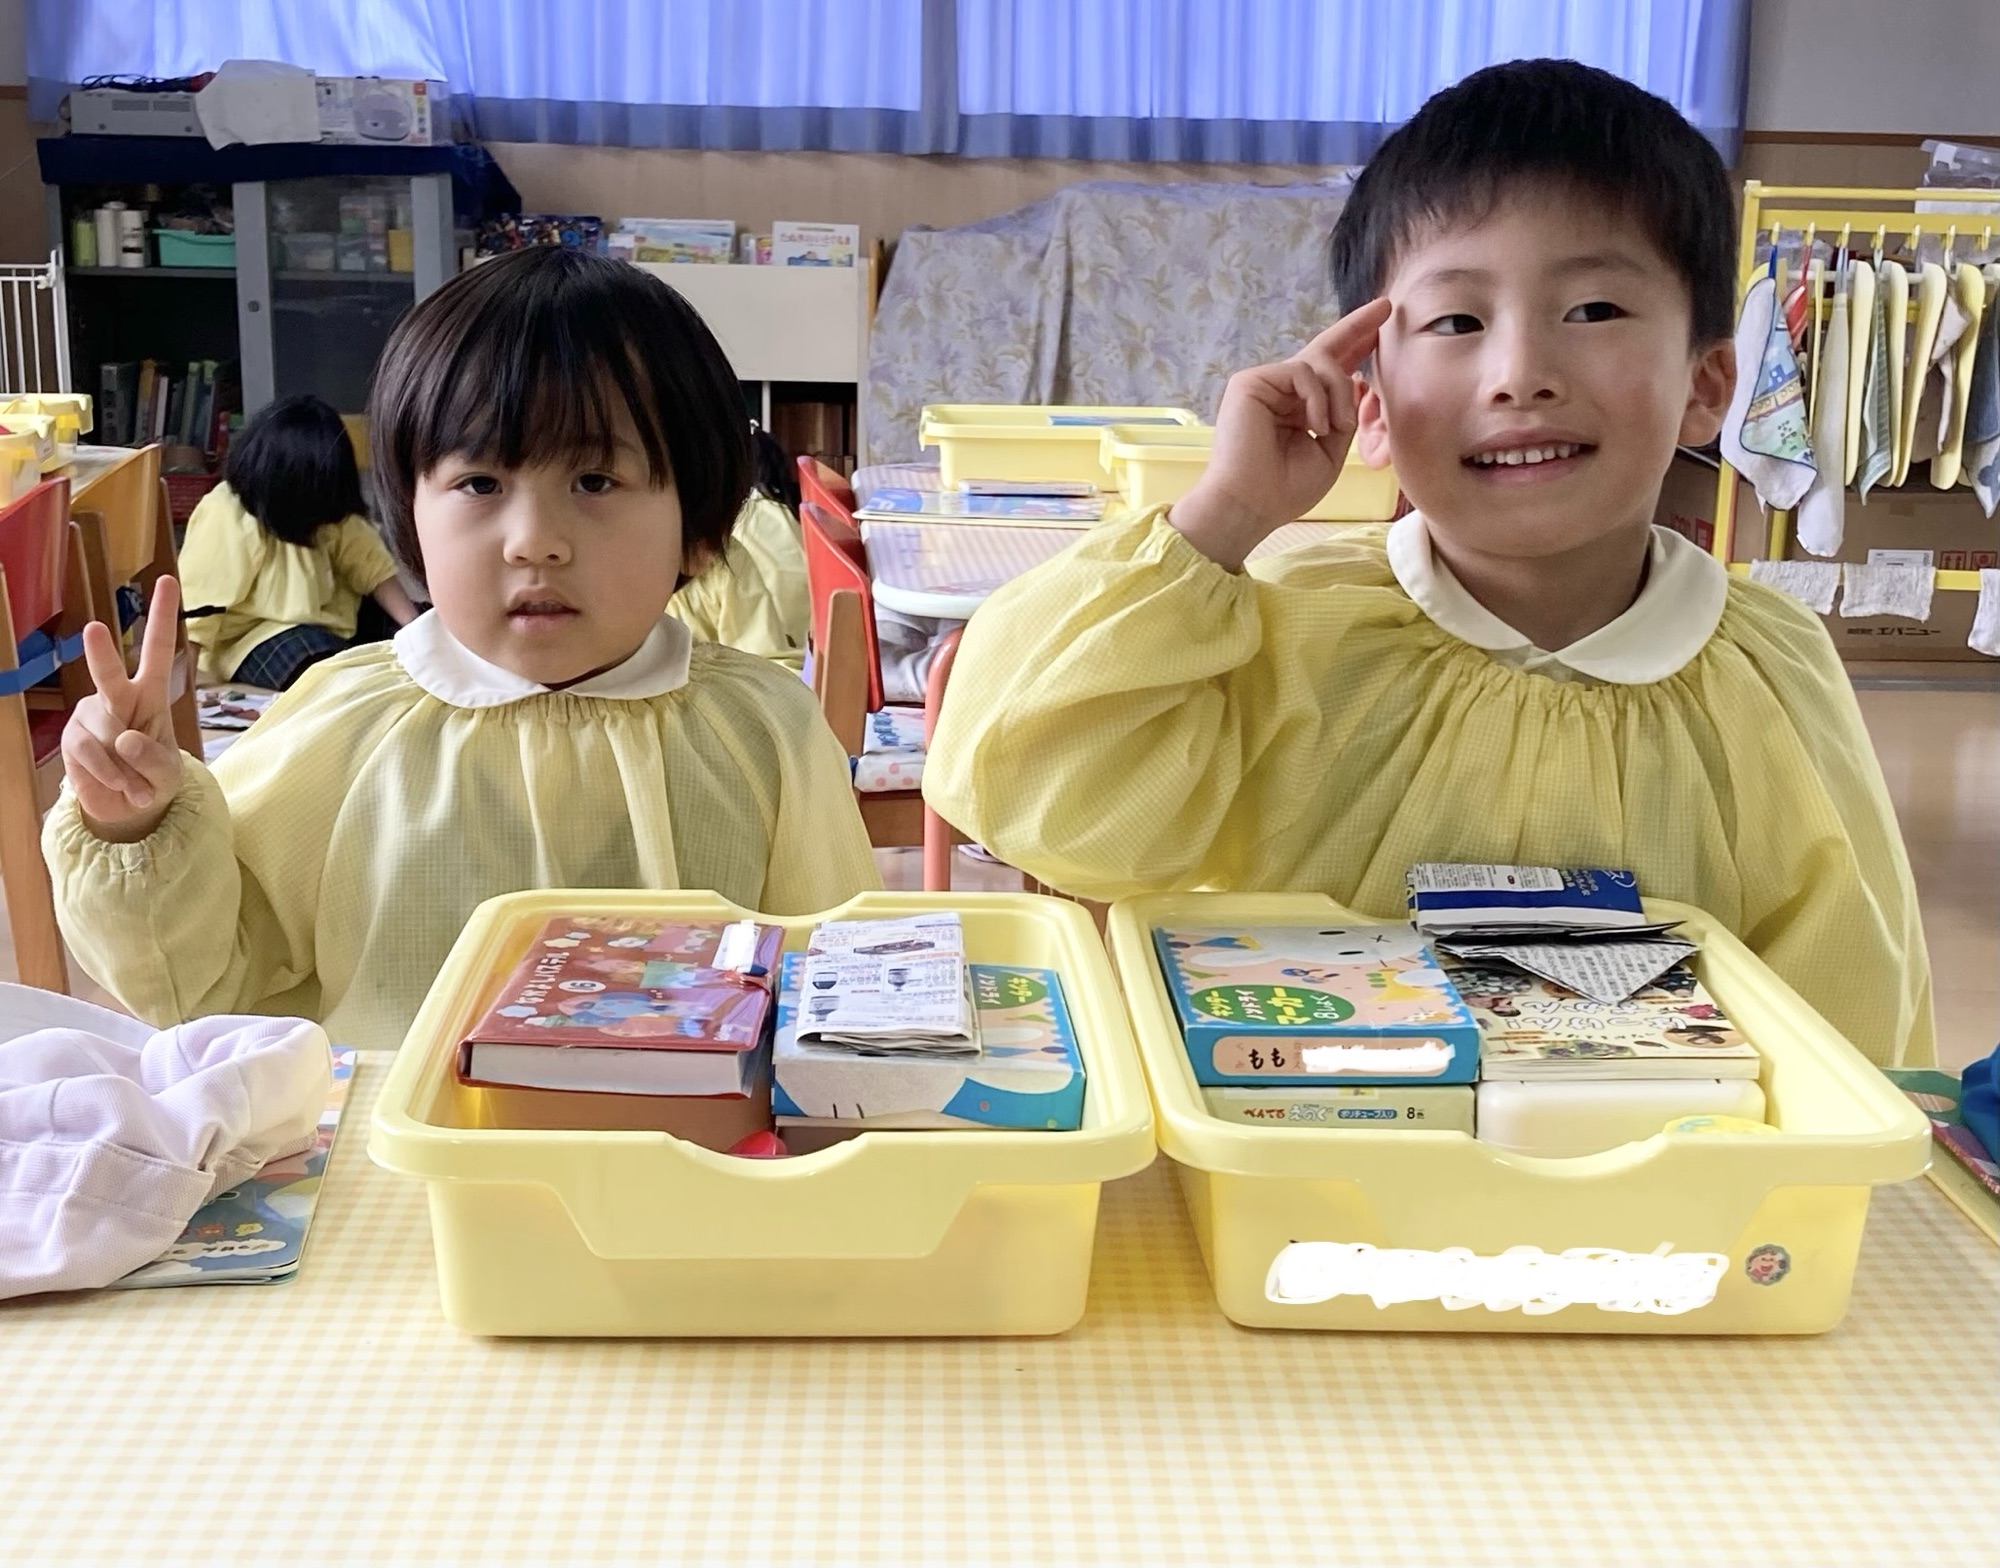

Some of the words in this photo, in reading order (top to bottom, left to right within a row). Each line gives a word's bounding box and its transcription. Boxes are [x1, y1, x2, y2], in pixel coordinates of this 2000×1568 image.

[1235, 989, 1266, 1020] ノンドライ
[1266, 987, 1311, 1025] マーカー
[1309, 995, 1340, 1020] 8しょく
[1248, 1048, 1286, 1070] もも
